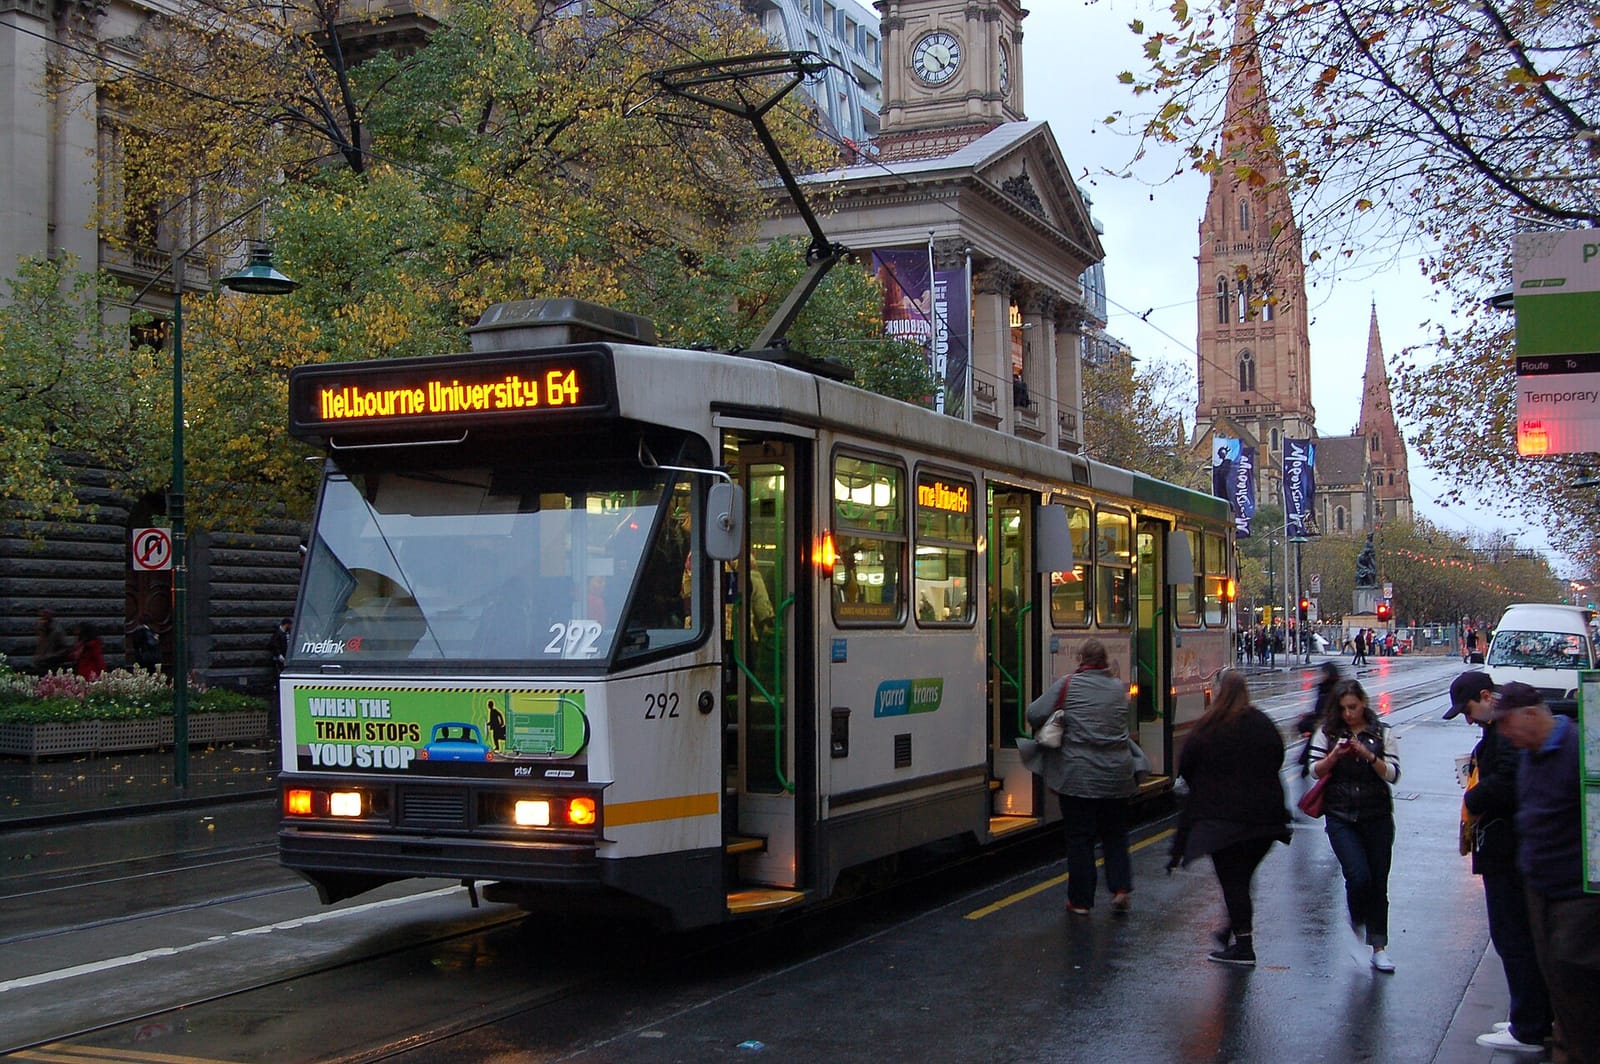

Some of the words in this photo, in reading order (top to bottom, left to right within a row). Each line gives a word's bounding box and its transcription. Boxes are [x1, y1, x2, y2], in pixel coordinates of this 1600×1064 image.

[1583, 243, 1600, 263] P
[1521, 361, 1550, 371] Route
[1567, 359, 1577, 369] To
[321, 388, 425, 419] Melbourne
[428, 375, 538, 412] University
[547, 370, 579, 405] 64
[1524, 391, 1599, 405] Temporary
[1523, 420, 1542, 429] Hail
[301, 639, 346, 654] metlink
[543, 621, 602, 655] 292
[308, 697, 357, 718] WHEN
[359, 699, 392, 719] THE
[644, 692, 680, 720] 292
[880, 688, 905, 713] yarra
[913, 685, 938, 705] trams
[315, 720, 361, 741] TRAM
[365, 721, 421, 743] STOPS
[308, 743, 353, 767] YOU
[355, 744, 416, 770] STOP
